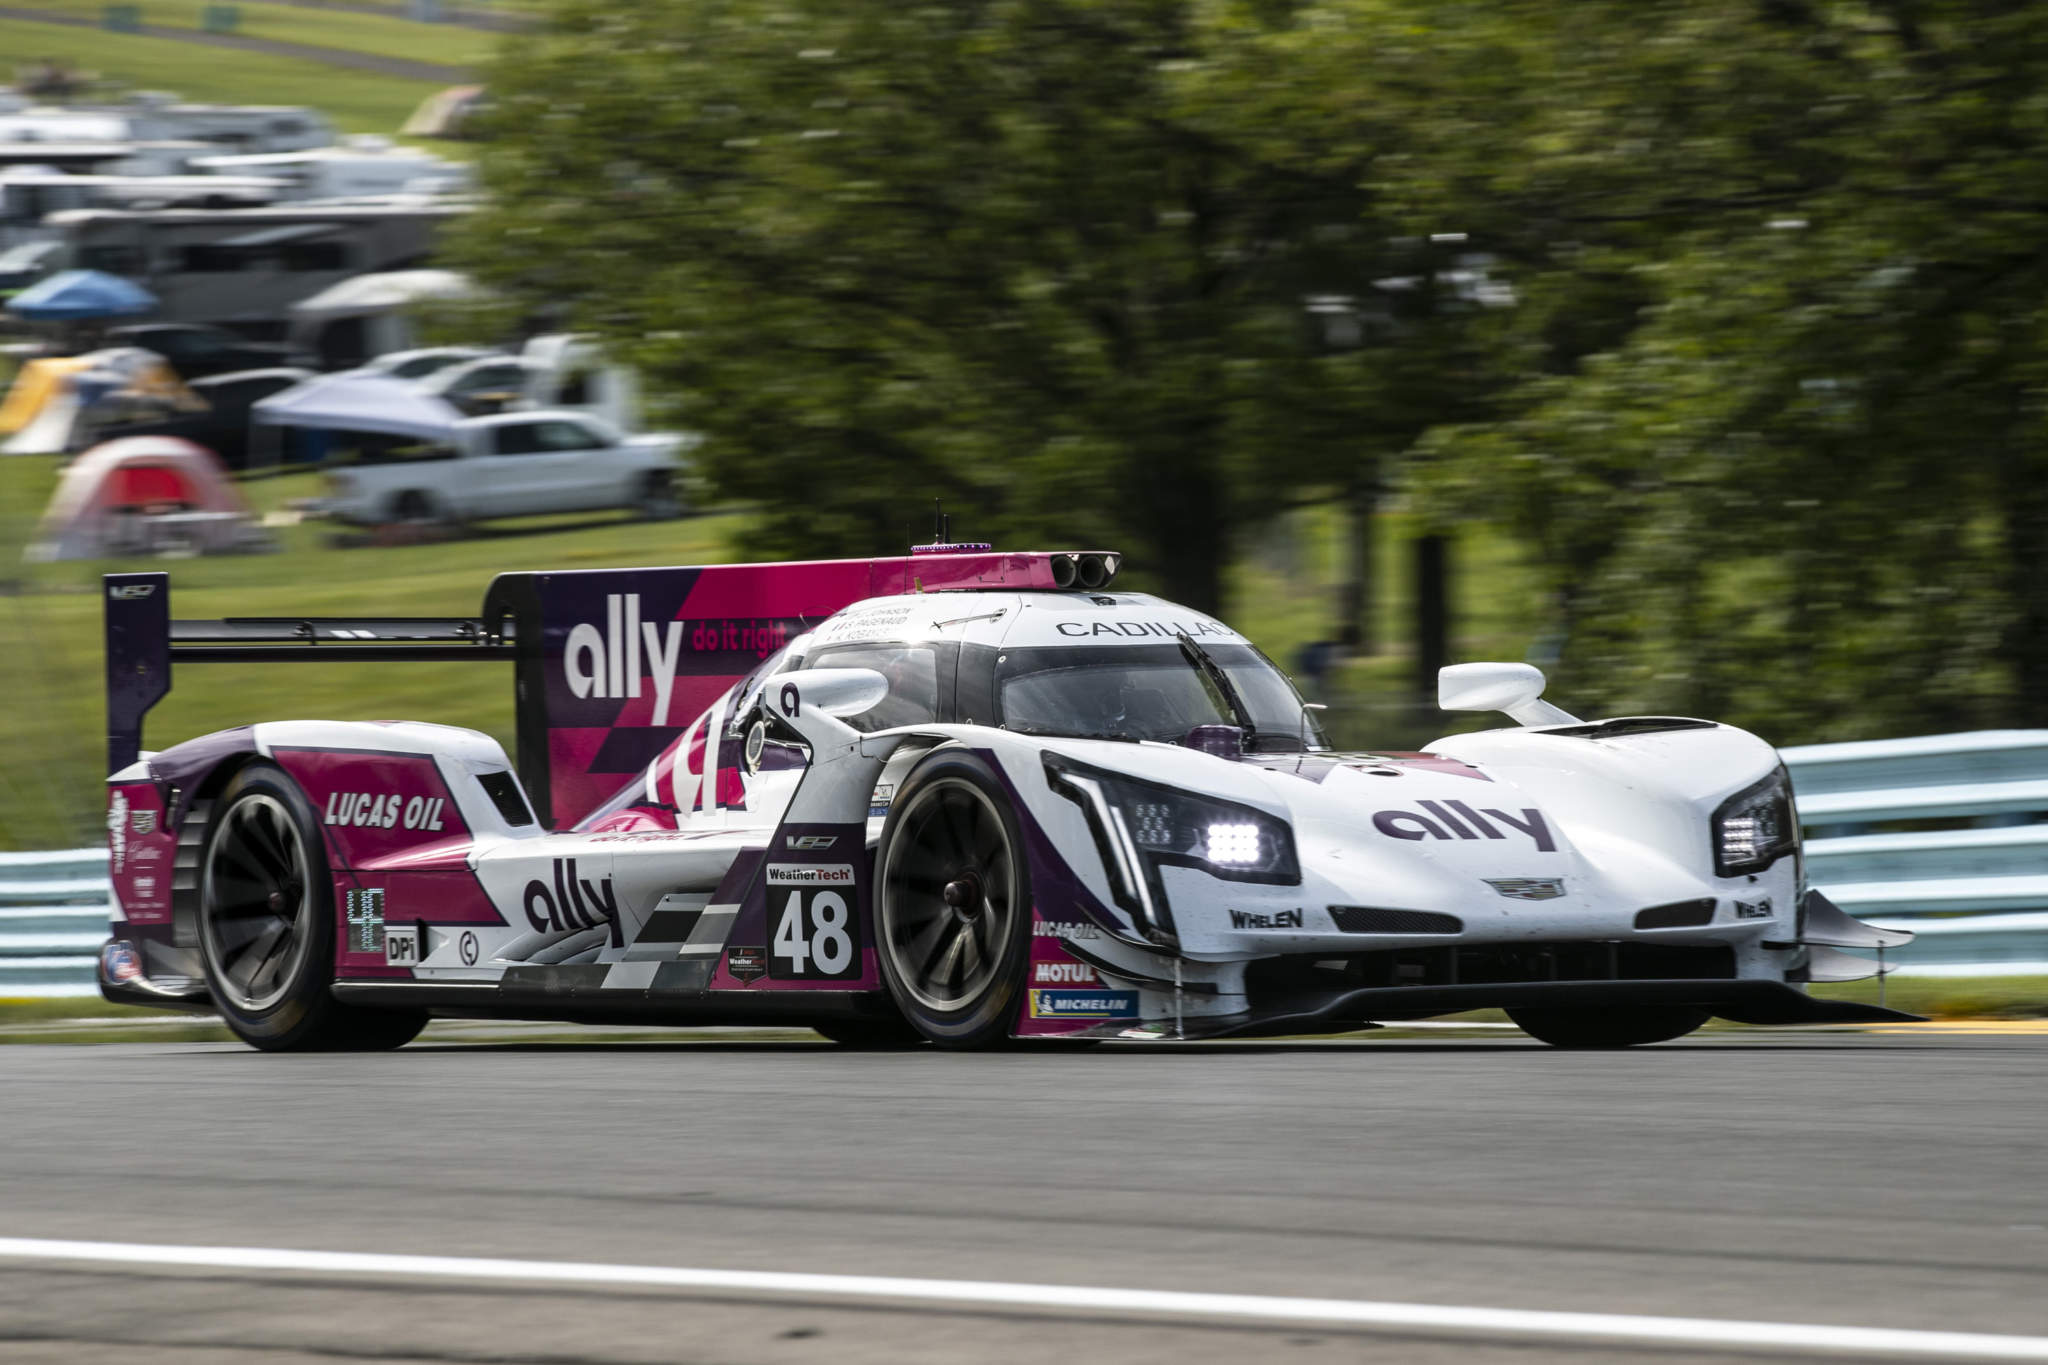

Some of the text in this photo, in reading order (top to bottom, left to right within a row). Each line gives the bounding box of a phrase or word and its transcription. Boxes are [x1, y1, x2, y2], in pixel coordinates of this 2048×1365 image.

[693, 619, 787, 659] do it right
[1055, 621, 1234, 638] CADILLAC
[564, 593, 684, 726] ally
[324, 792, 445, 831] LUCAS OIL
[1372, 799, 1557, 852] ally
[769, 868, 850, 880] WeatherTech
[523, 858, 625, 948] ally
[1033, 921, 1072, 938] LUCAS
[1228, 907, 1304, 929] WHELEN
[774, 890, 852, 974] 48
[388, 936, 415, 961] DPi
[1035, 963, 1095, 982] MOTUL
[1054, 999, 1127, 1010] MICHELIN
